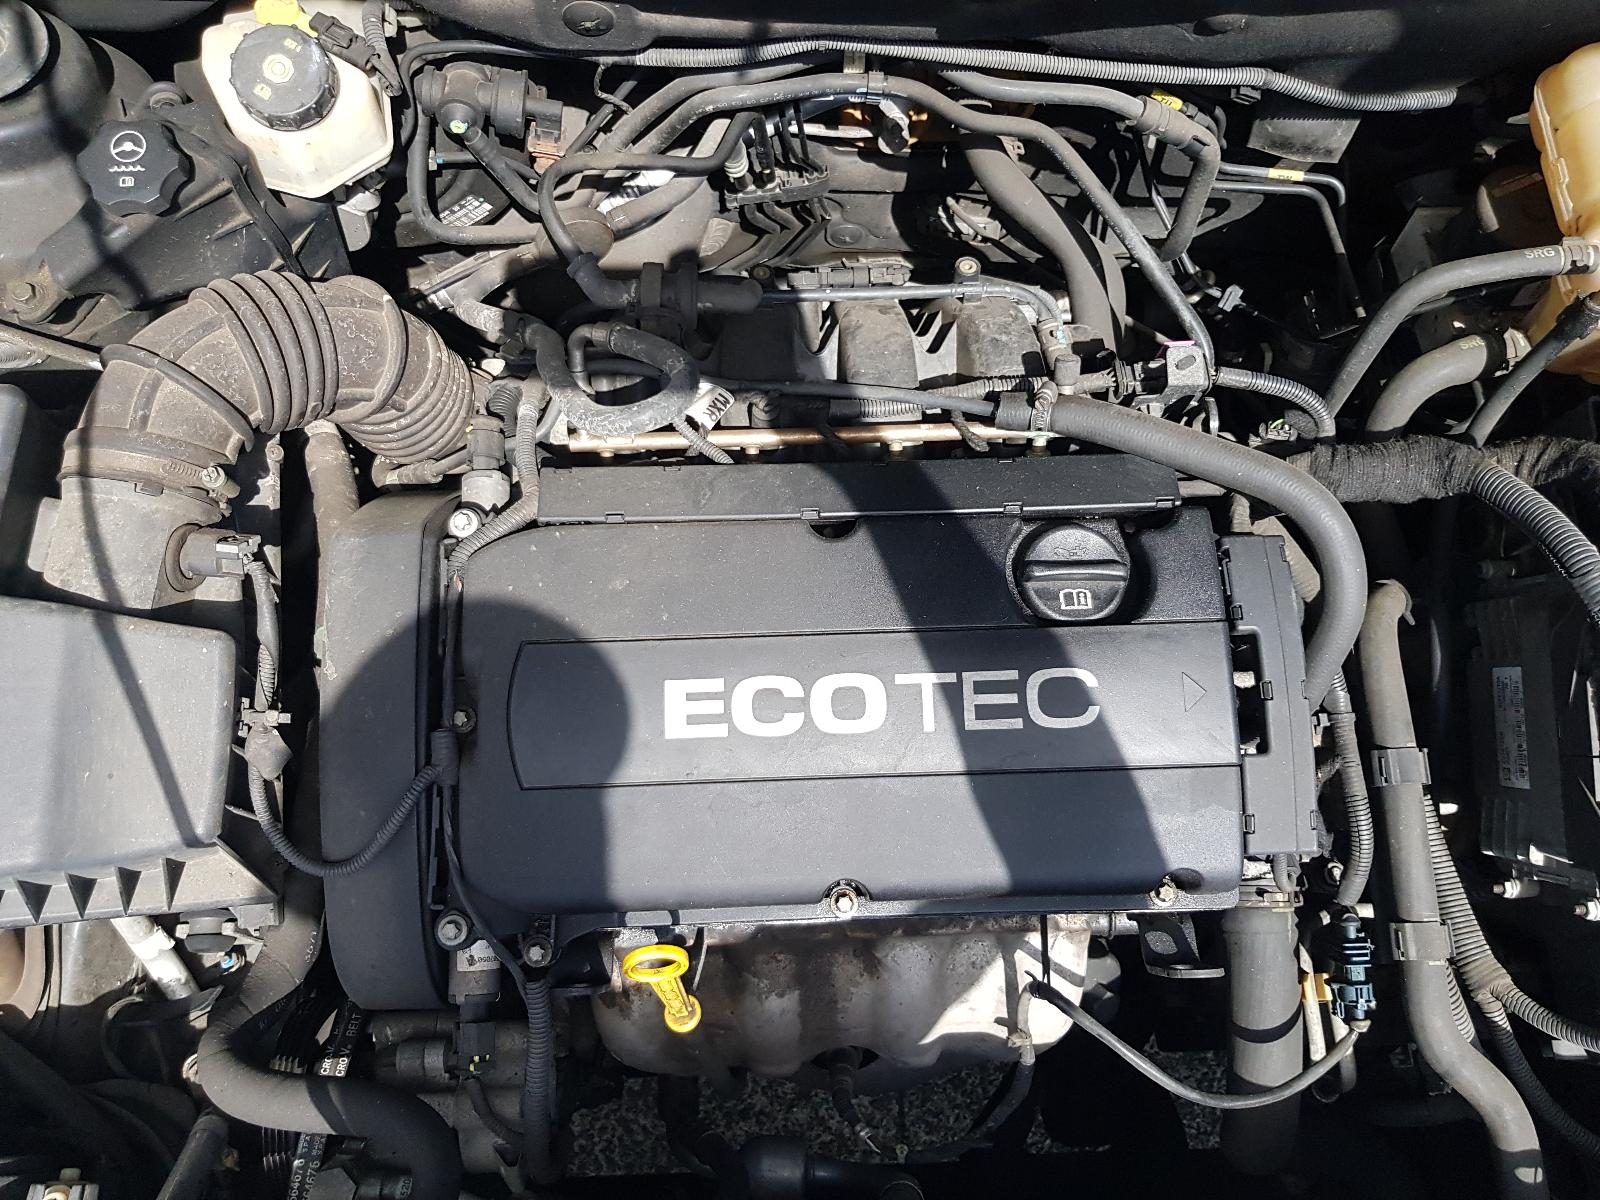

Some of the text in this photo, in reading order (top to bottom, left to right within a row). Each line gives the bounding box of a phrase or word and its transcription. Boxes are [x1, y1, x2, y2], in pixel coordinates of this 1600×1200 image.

[1524, 247, 1555, 259] SRG
[703, 392, 731, 422] MXR
[664, 667, 1101, 739] ECOTEC
